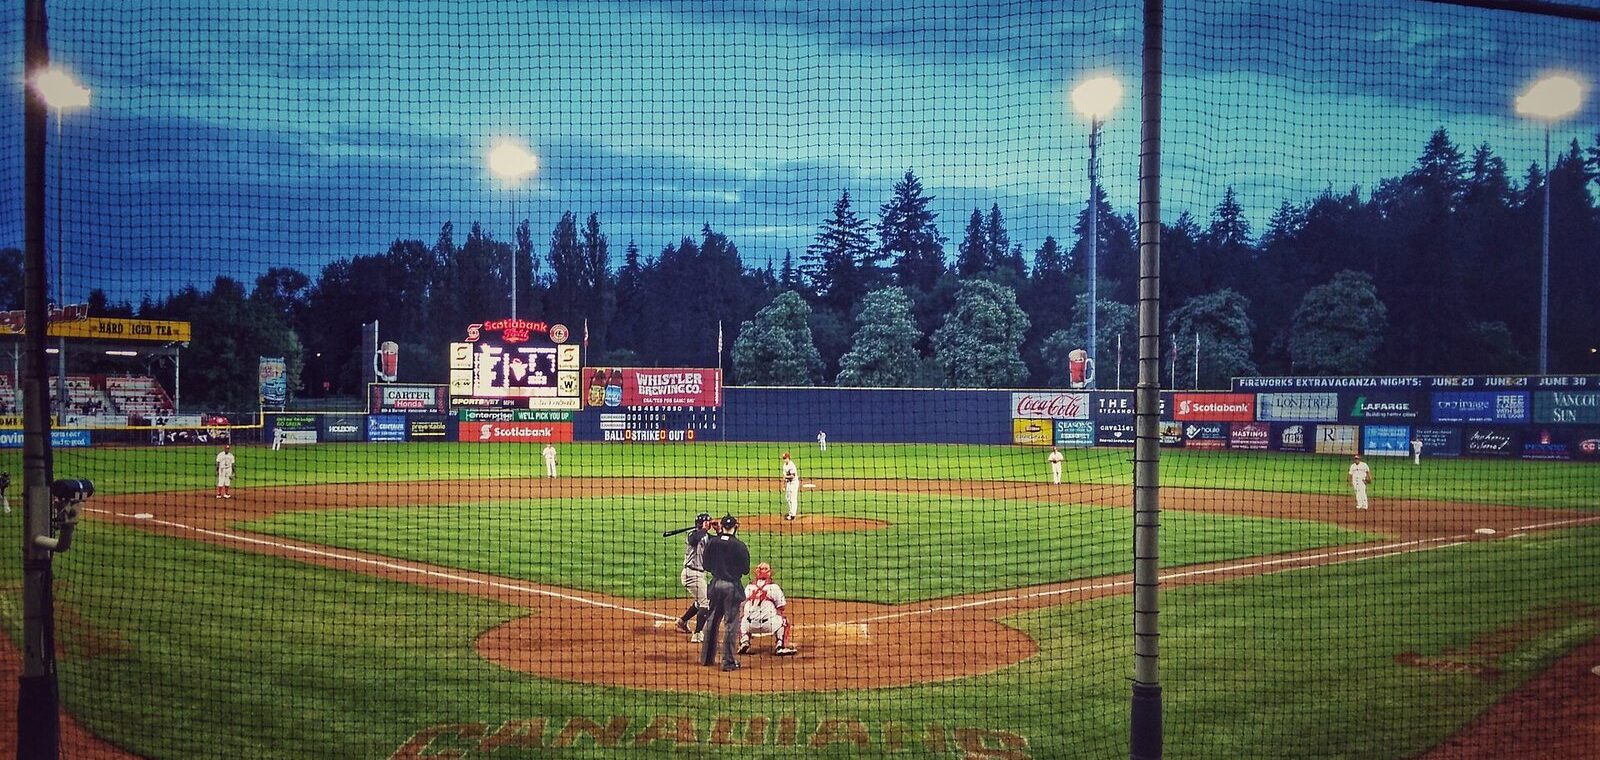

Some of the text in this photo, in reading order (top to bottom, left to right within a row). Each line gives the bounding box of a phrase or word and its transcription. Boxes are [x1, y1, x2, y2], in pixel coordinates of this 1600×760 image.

[98, 322, 172, 336] HARD ICED TEA
[484, 318, 549, 333] Scotiabank
[636, 372, 703, 386] WHISTLER
[1296, 378, 1378, 387] EXTRAVAGANZA
[1380, 377, 1422, 387] NIGHTS:
[1431, 377, 1461, 387] JUNE
[1461, 377, 1475, 387] 20
[1485, 377, 1514, 387] JUNE
[1515, 377, 1528, 386] 21
[1538, 376, 1569, 386] JUNE
[1572, 376, 1587, 386] 30
[638, 384, 703, 396] BREWING CO.
[388, 391, 431, 400] CARTER
[1496, 395, 1525, 404] FREE
[1099, 398, 1127, 408] THE
[1193, 403, 1249, 413] Scotiabank
[1361, 403, 1410, 411] LAFARGE
[468, 411, 513, 420] enterprise
[518, 412, 570, 420] WE'LL PICK YOU UP
[1553, 408, 1577, 422] SUN
[493, 427, 552, 437] Scotiabank
[604, 430, 694, 441] BALL 0 STRIKE 0 OUT 0
